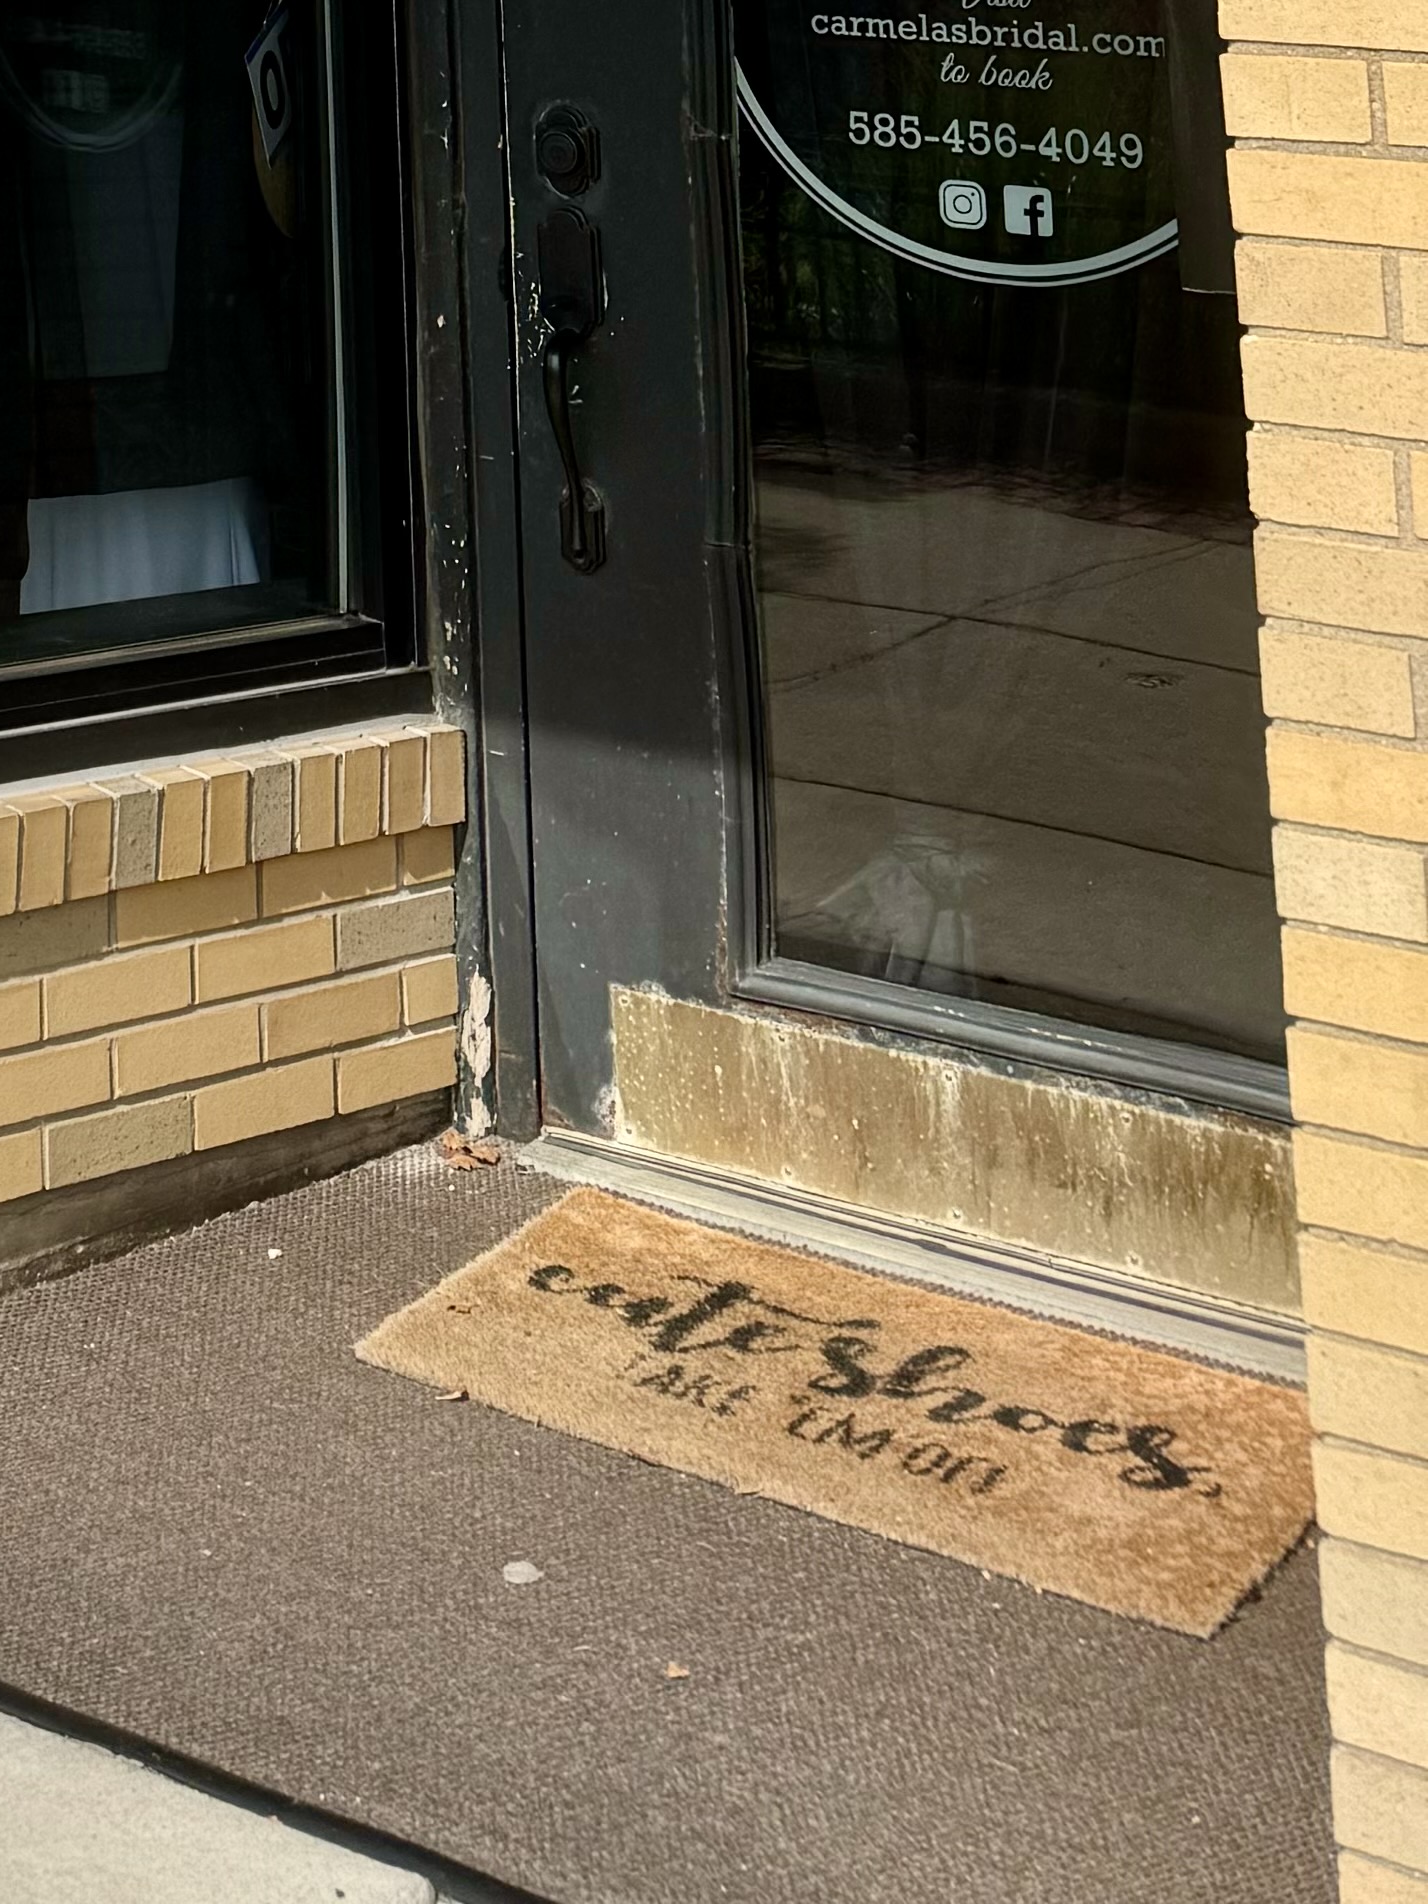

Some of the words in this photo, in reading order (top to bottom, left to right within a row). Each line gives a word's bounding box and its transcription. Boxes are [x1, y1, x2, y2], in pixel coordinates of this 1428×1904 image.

[810, 14, 1166, 58] carmelasbridal.com
[940, 52, 971, 85] to
[977, 53, 1054, 91] book
[848, 110, 1144, 169] 585-456-4049
